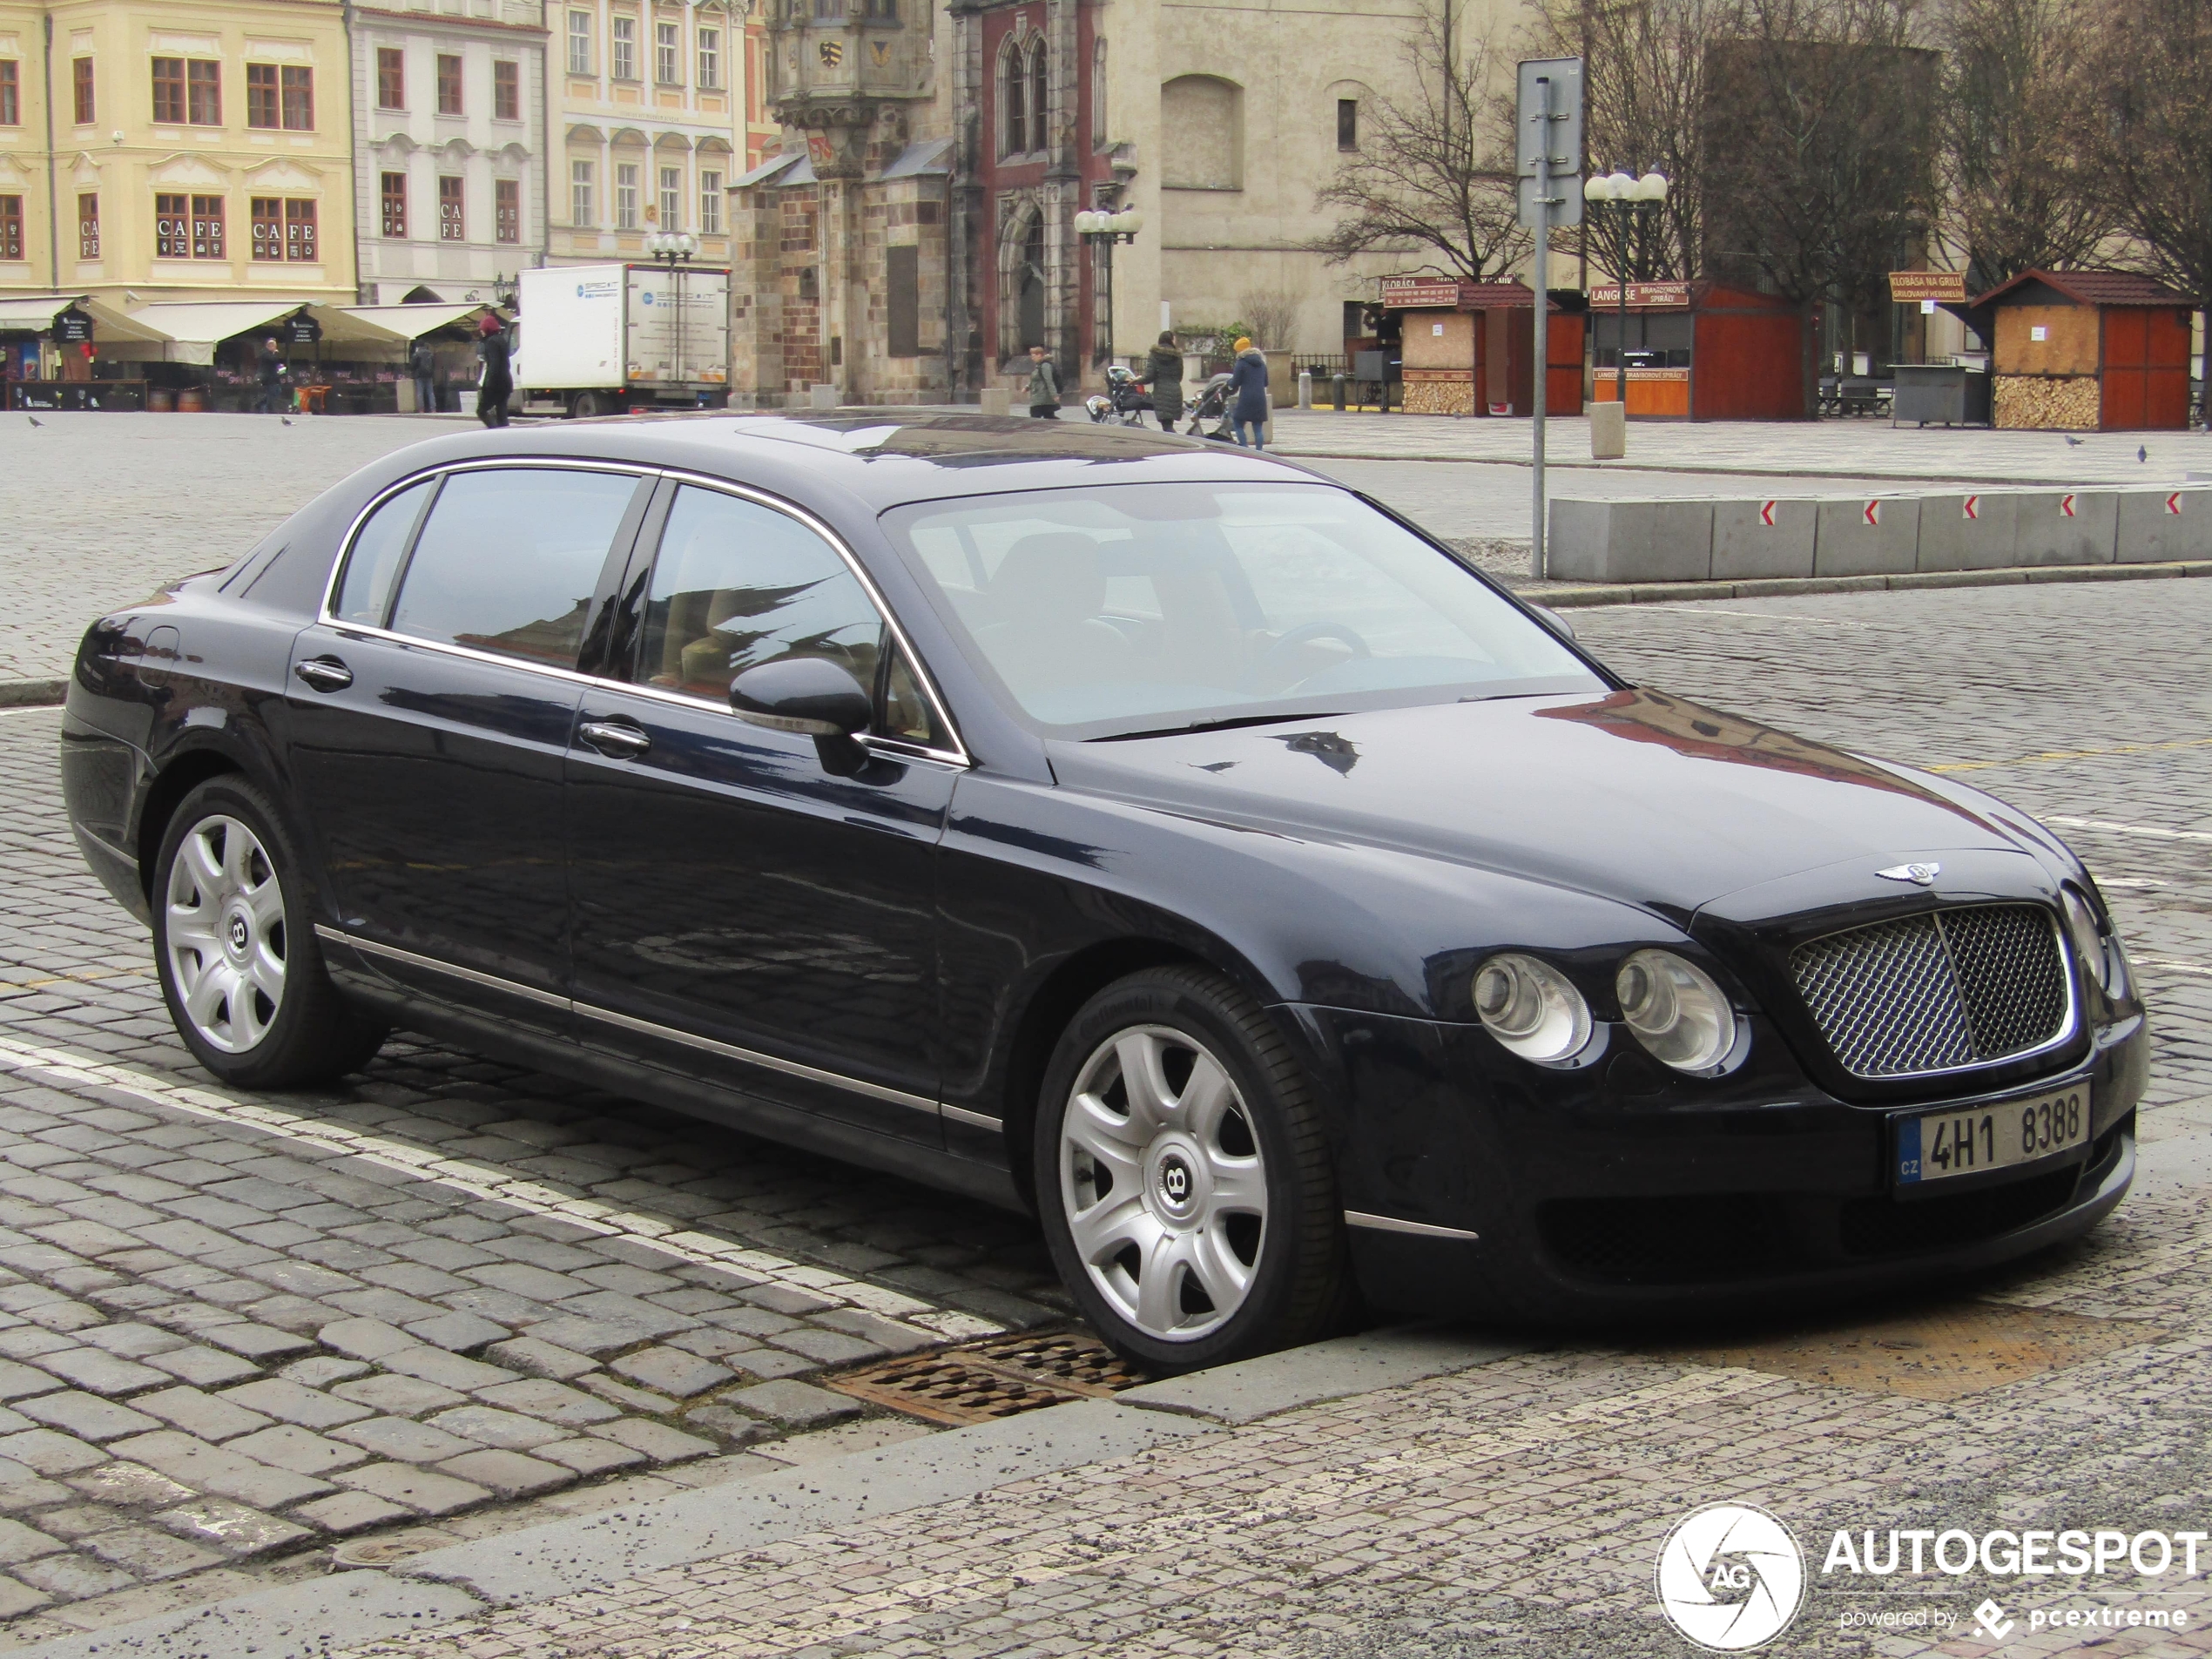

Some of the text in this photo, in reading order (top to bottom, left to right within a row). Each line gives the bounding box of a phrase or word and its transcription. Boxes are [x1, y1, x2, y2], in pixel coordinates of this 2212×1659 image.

[158, 220, 222, 238] CAFE
[253, 224, 314, 239] CAFE
[1891, 274, 1962, 287] KLOBÁSA NA GRILU
[1640, 286, 1686, 294] BRAMBOROVÉ
[1893, 288, 1964, 298] GRILOVANÝ HERMELÍN
[1649, 293, 1675, 303] SPIRÁLY
[1931, 1093, 2080, 1170] 4H1 8388
[1900, 1160, 1919, 1176] CZ
